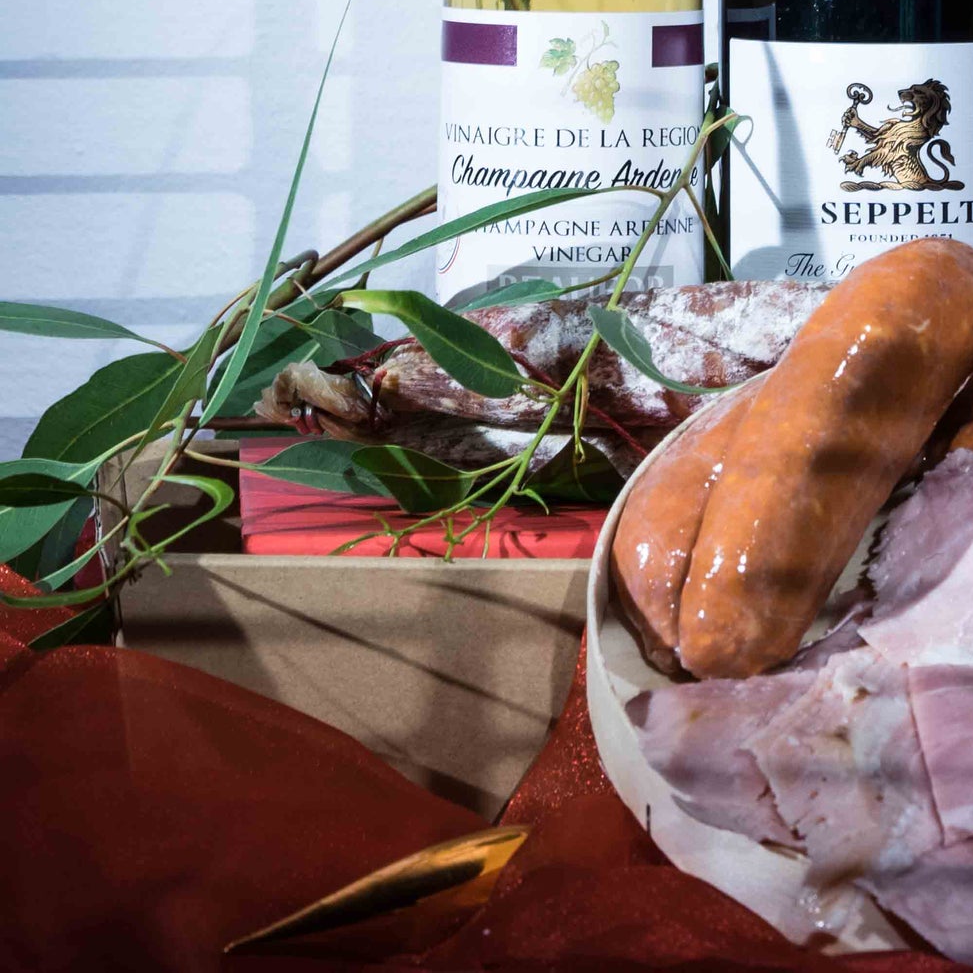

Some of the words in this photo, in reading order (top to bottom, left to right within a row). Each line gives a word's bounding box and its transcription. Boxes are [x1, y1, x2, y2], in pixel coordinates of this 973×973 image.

[446, 123, 545, 147] VINAIGRE
[555, 127, 590, 148] DE
[600, 129, 632, 148] LA
[642, 125, 701, 147] REGIO
[451, 154, 602, 196] Champagne
[611, 158, 699, 190] Ardene
[474, 219, 600, 236] AMPAGNE
[532, 246, 633, 263] VINEGAR
[784, 253, 827, 278] The
